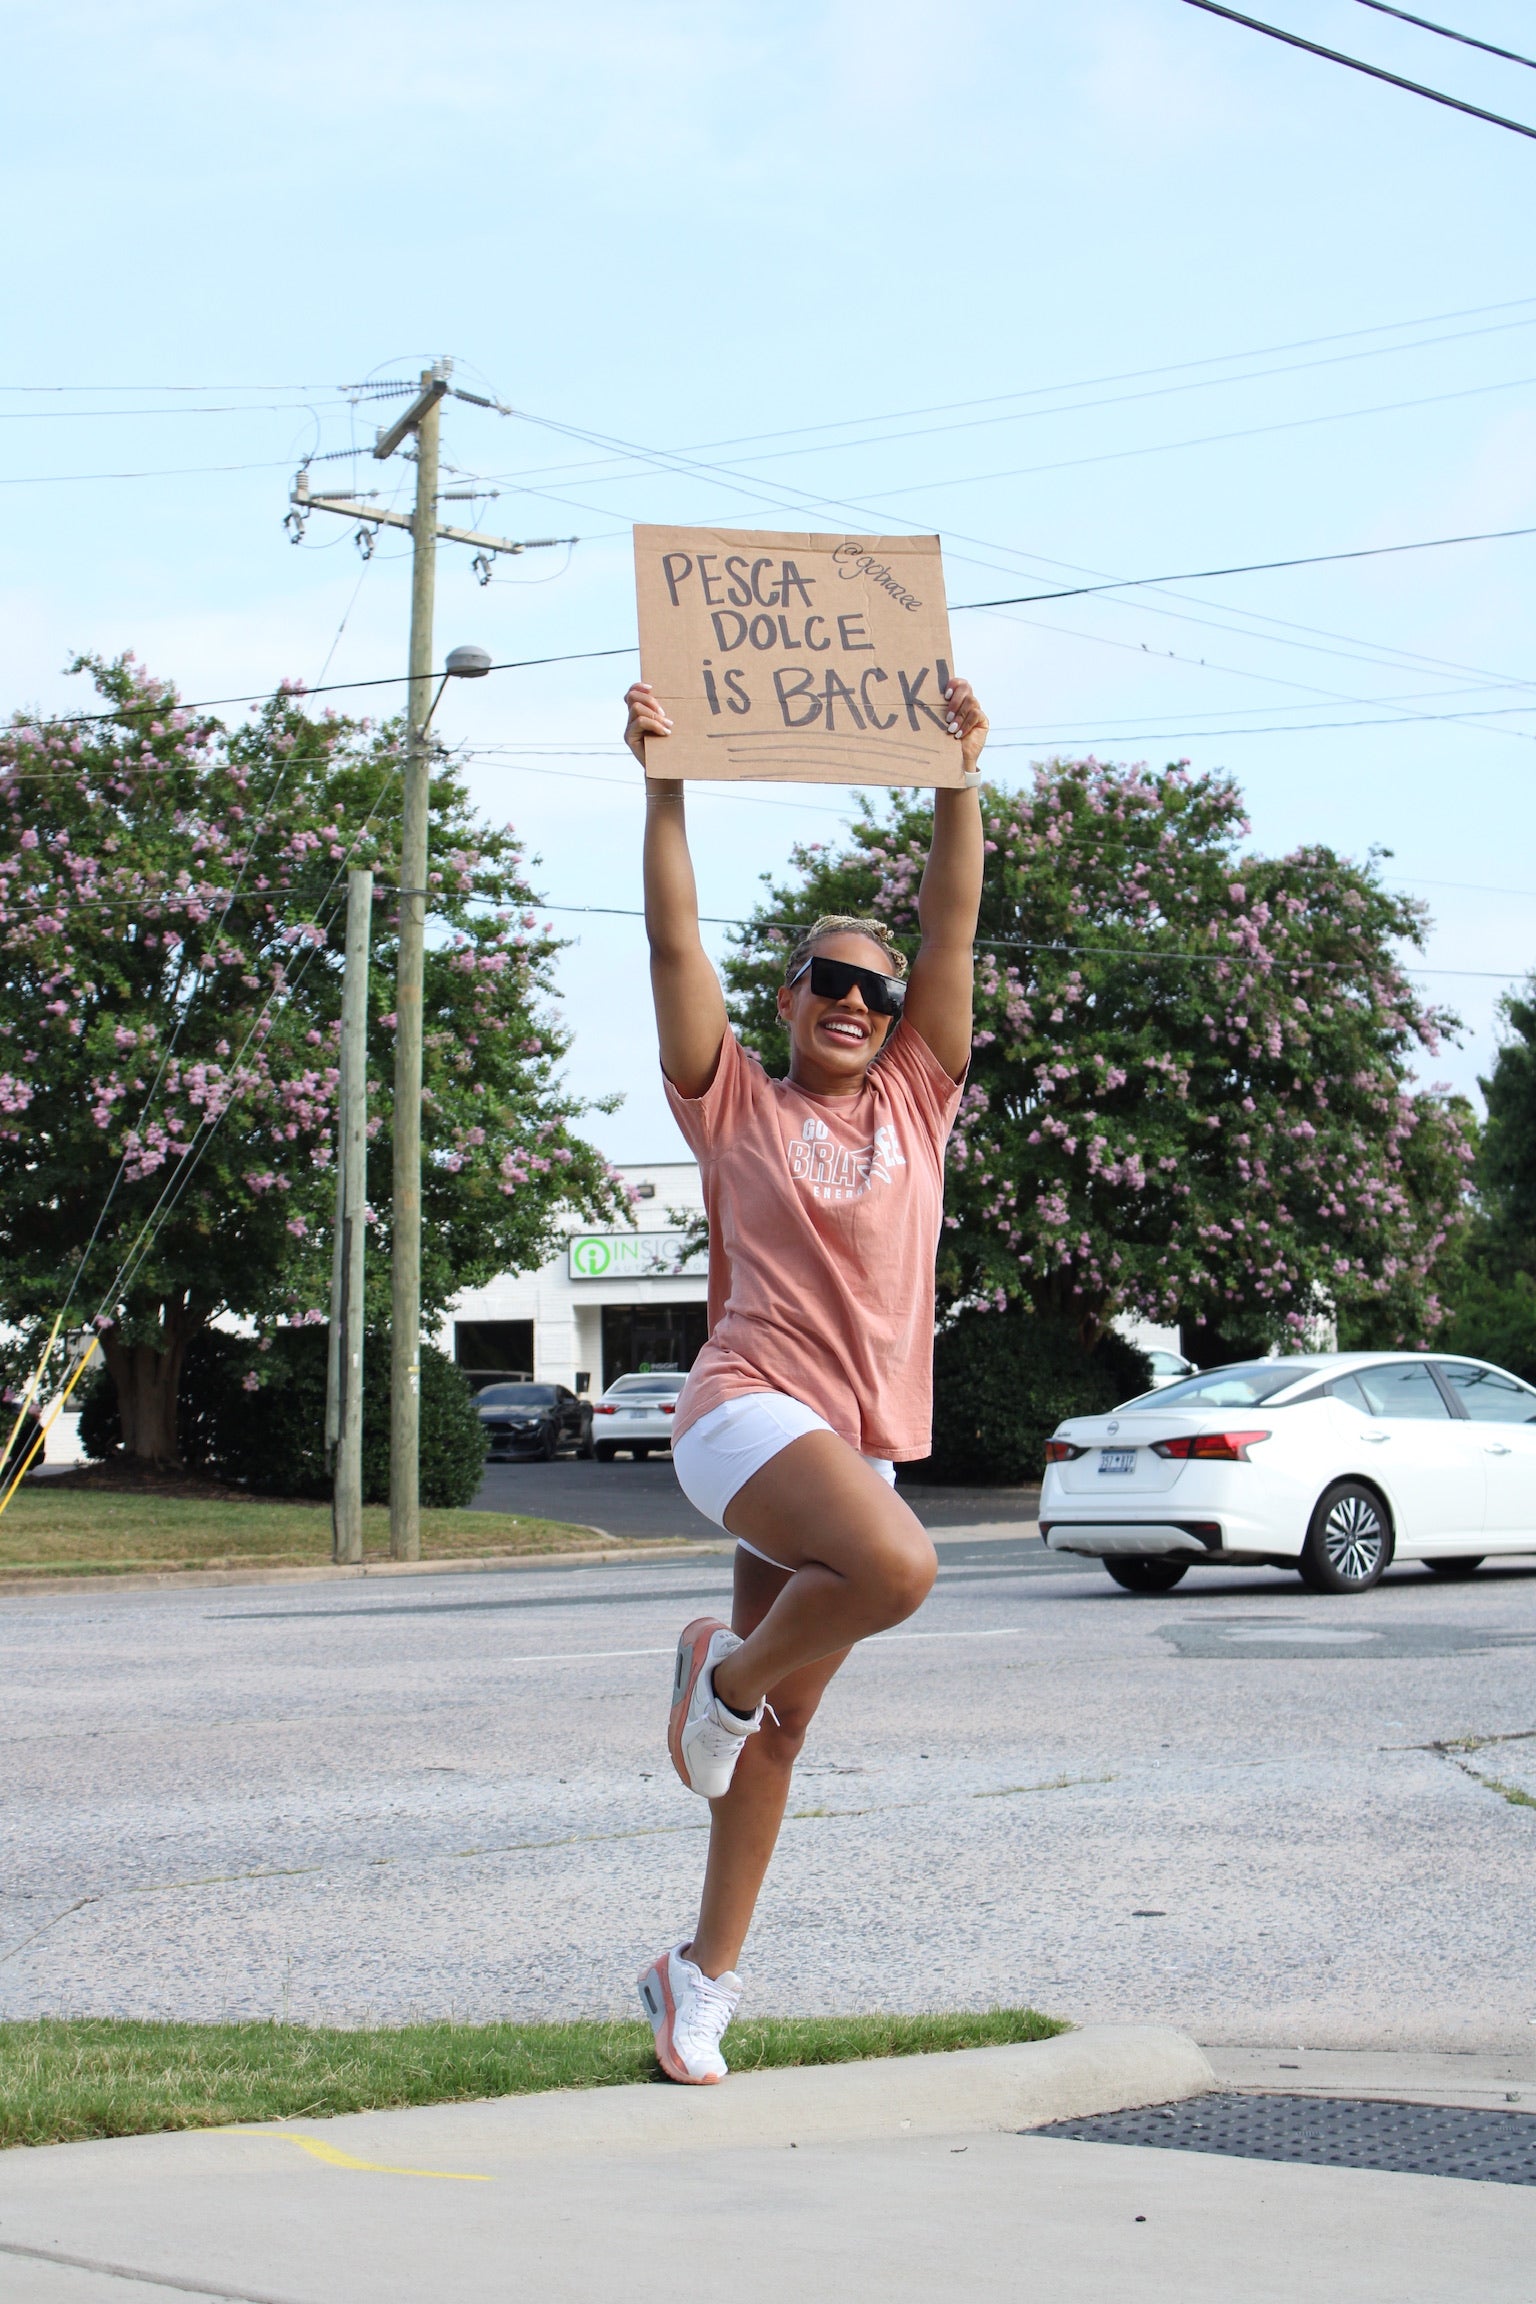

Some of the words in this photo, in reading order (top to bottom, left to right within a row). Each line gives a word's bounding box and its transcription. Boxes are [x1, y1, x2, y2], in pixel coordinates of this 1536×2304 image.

[662, 553, 816, 608] PESCA
[710, 609, 876, 652] DOLCE
[802, 1118, 829, 1141] GO
